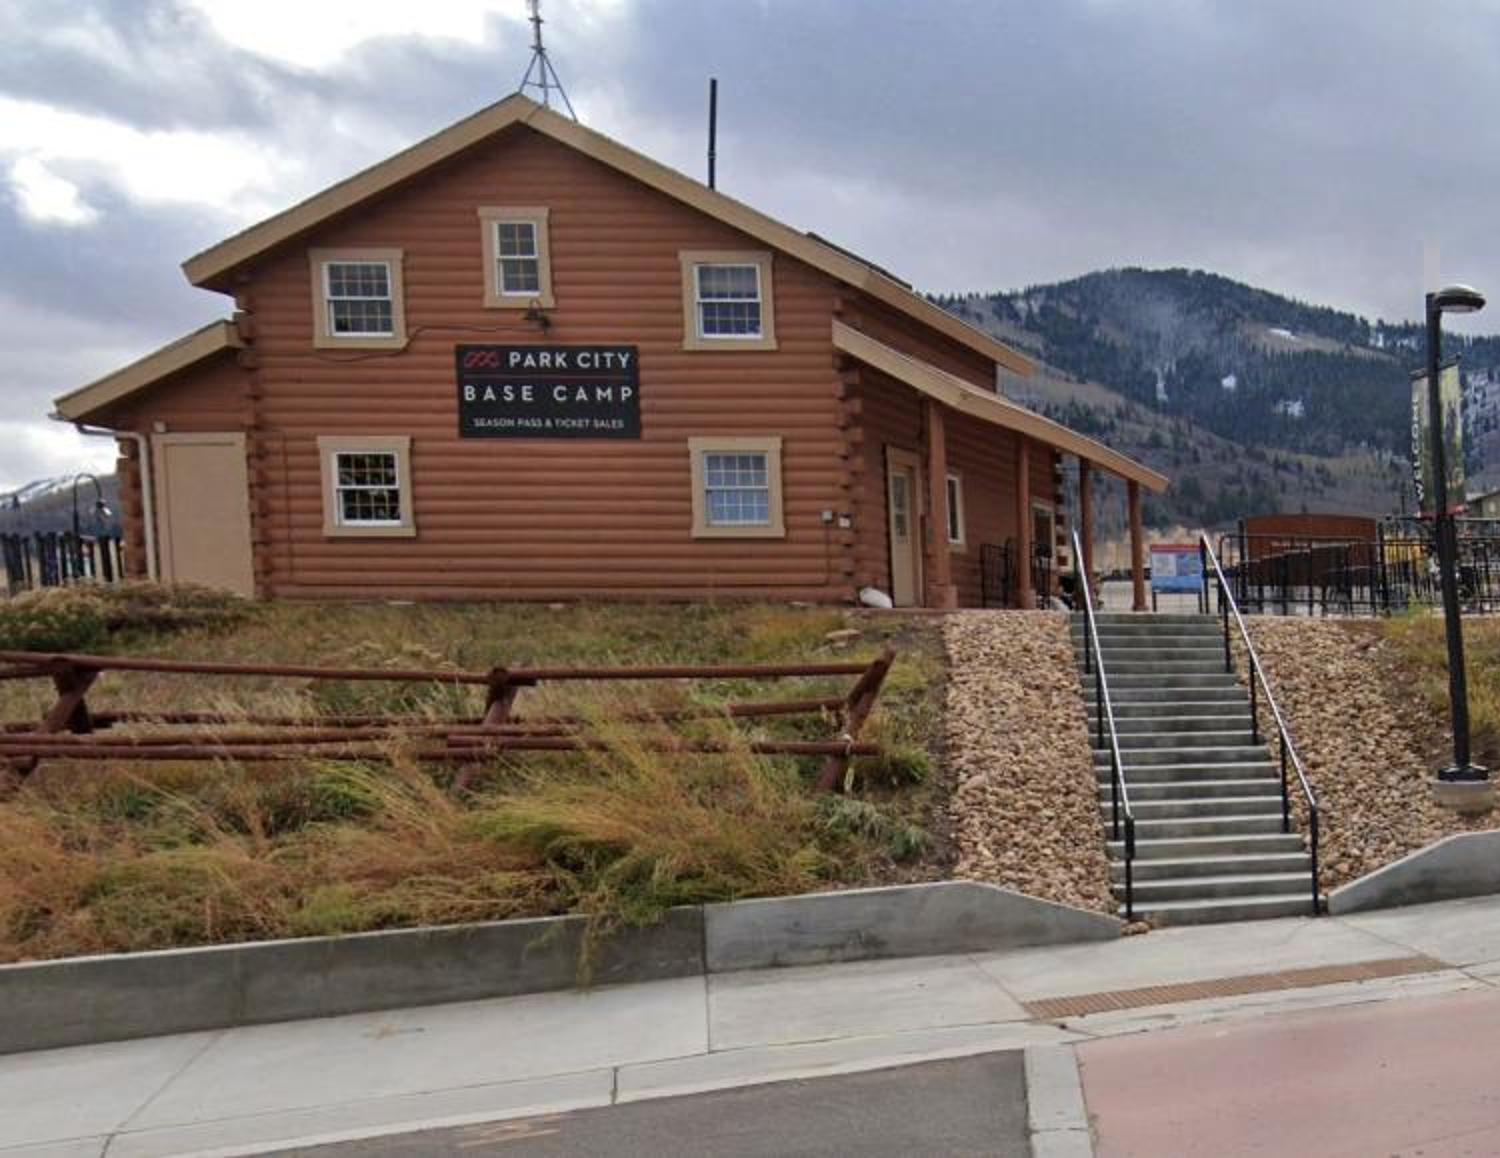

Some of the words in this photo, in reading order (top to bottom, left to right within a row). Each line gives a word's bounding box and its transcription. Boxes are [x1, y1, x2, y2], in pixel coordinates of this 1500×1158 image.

[509, 352, 568, 368] PARK
[577, 352, 631, 368] CITY
[464, 385, 534, 401] BASE
[553, 385, 633, 401] CAMP
[474, 417, 515, 428] SEASON
[517, 418, 543, 428] PASS
[545, 418, 553, 428] &
[555, 418, 590, 428] TICKET
[593, 418, 625, 429] SALES
[1411, 391, 1425, 501] WELCOME
